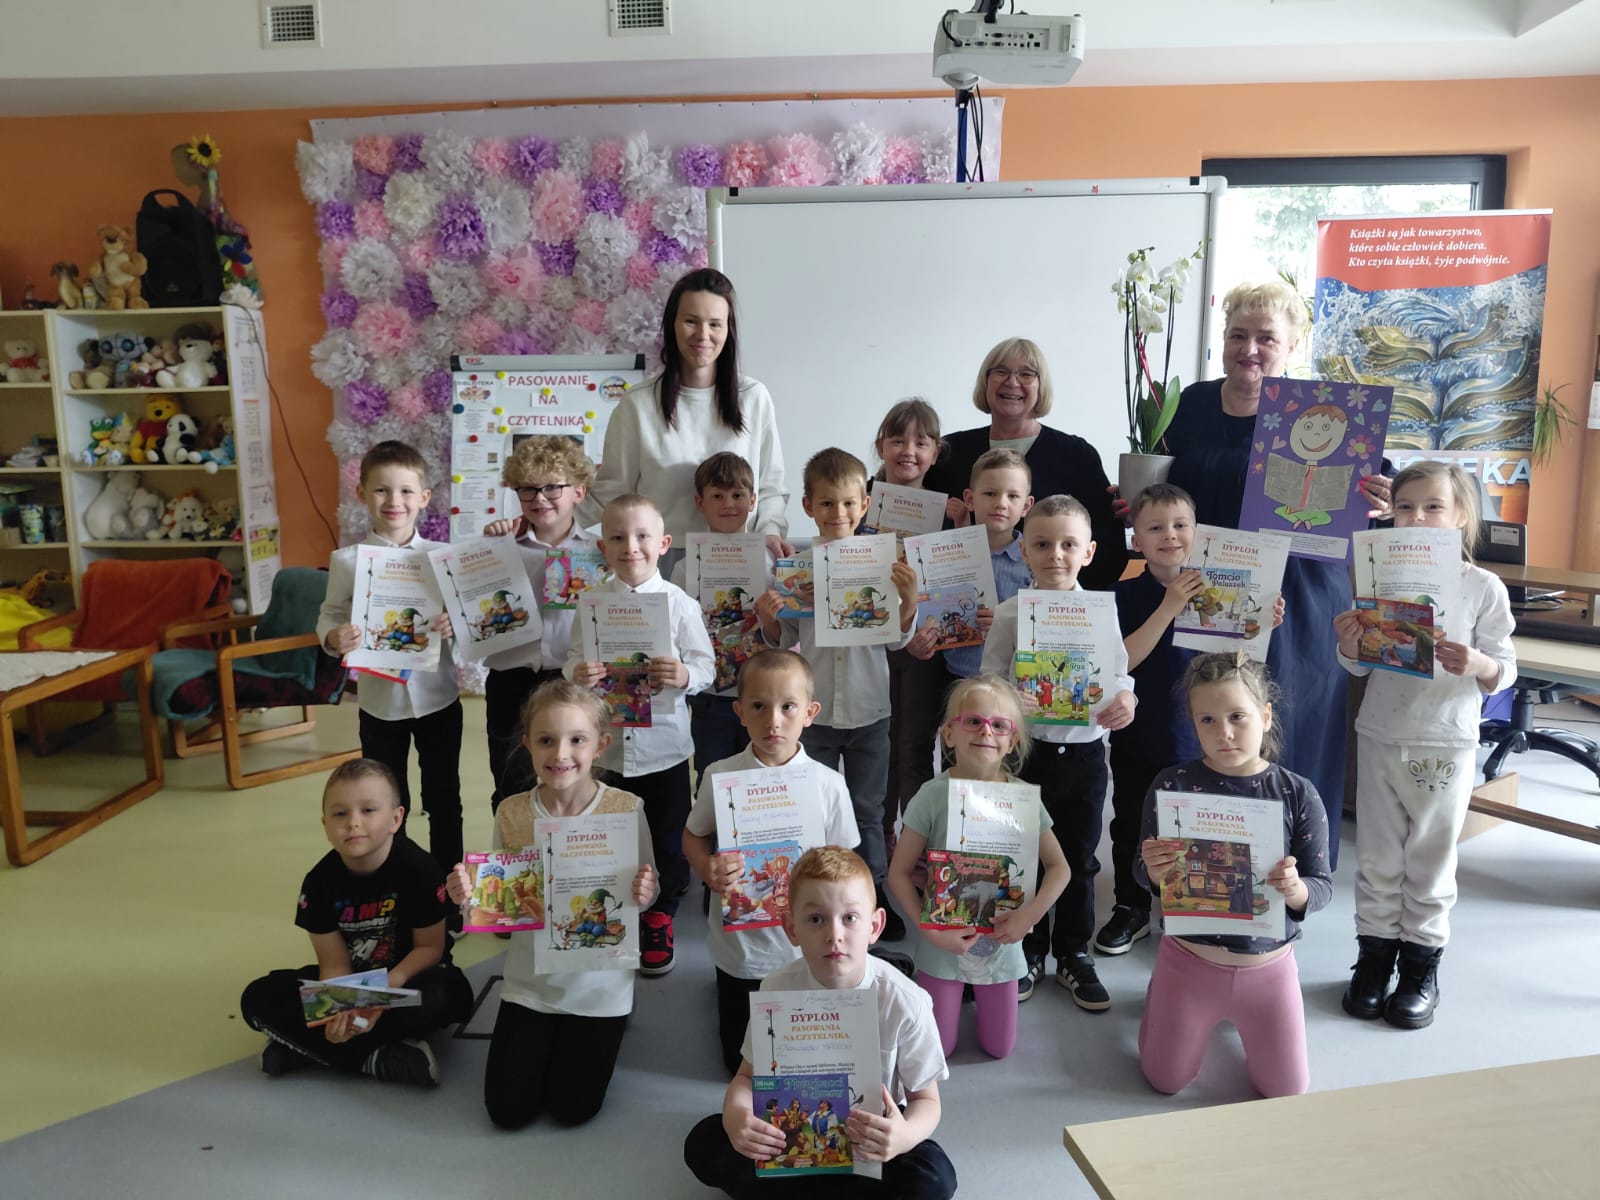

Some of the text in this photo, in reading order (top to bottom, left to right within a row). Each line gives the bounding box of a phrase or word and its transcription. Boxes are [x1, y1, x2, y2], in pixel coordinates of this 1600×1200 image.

[1350, 227, 1482, 240] Książki są jak towarzystwo,
[1349, 241, 1487, 253] które sobie człowiek dobiera.
[1348, 254, 1510, 268] Kto czyta książki, żyje podwójnie.
[508, 375, 589, 386] PASOWANIE
[539, 394, 558, 405] NA
[508, 415, 586, 426] CZYTELNIKA
[931, 543, 964, 553] DYPLOM
[1222, 543, 1259, 554] DYPLOM
[1389, 544, 1431, 552] DYPLOM
[1206, 570, 1241, 581] Tomcio
[1212, 580, 1246, 588] Paluszek
[747, 784, 788, 796] DYPLOM
[1196, 811, 1245, 822] DYPLOM
[566, 833, 607, 843] DYPLOM
[791, 1012, 840, 1023] DYPLOM
[791, 1023, 841, 1032] PASOWANIA
